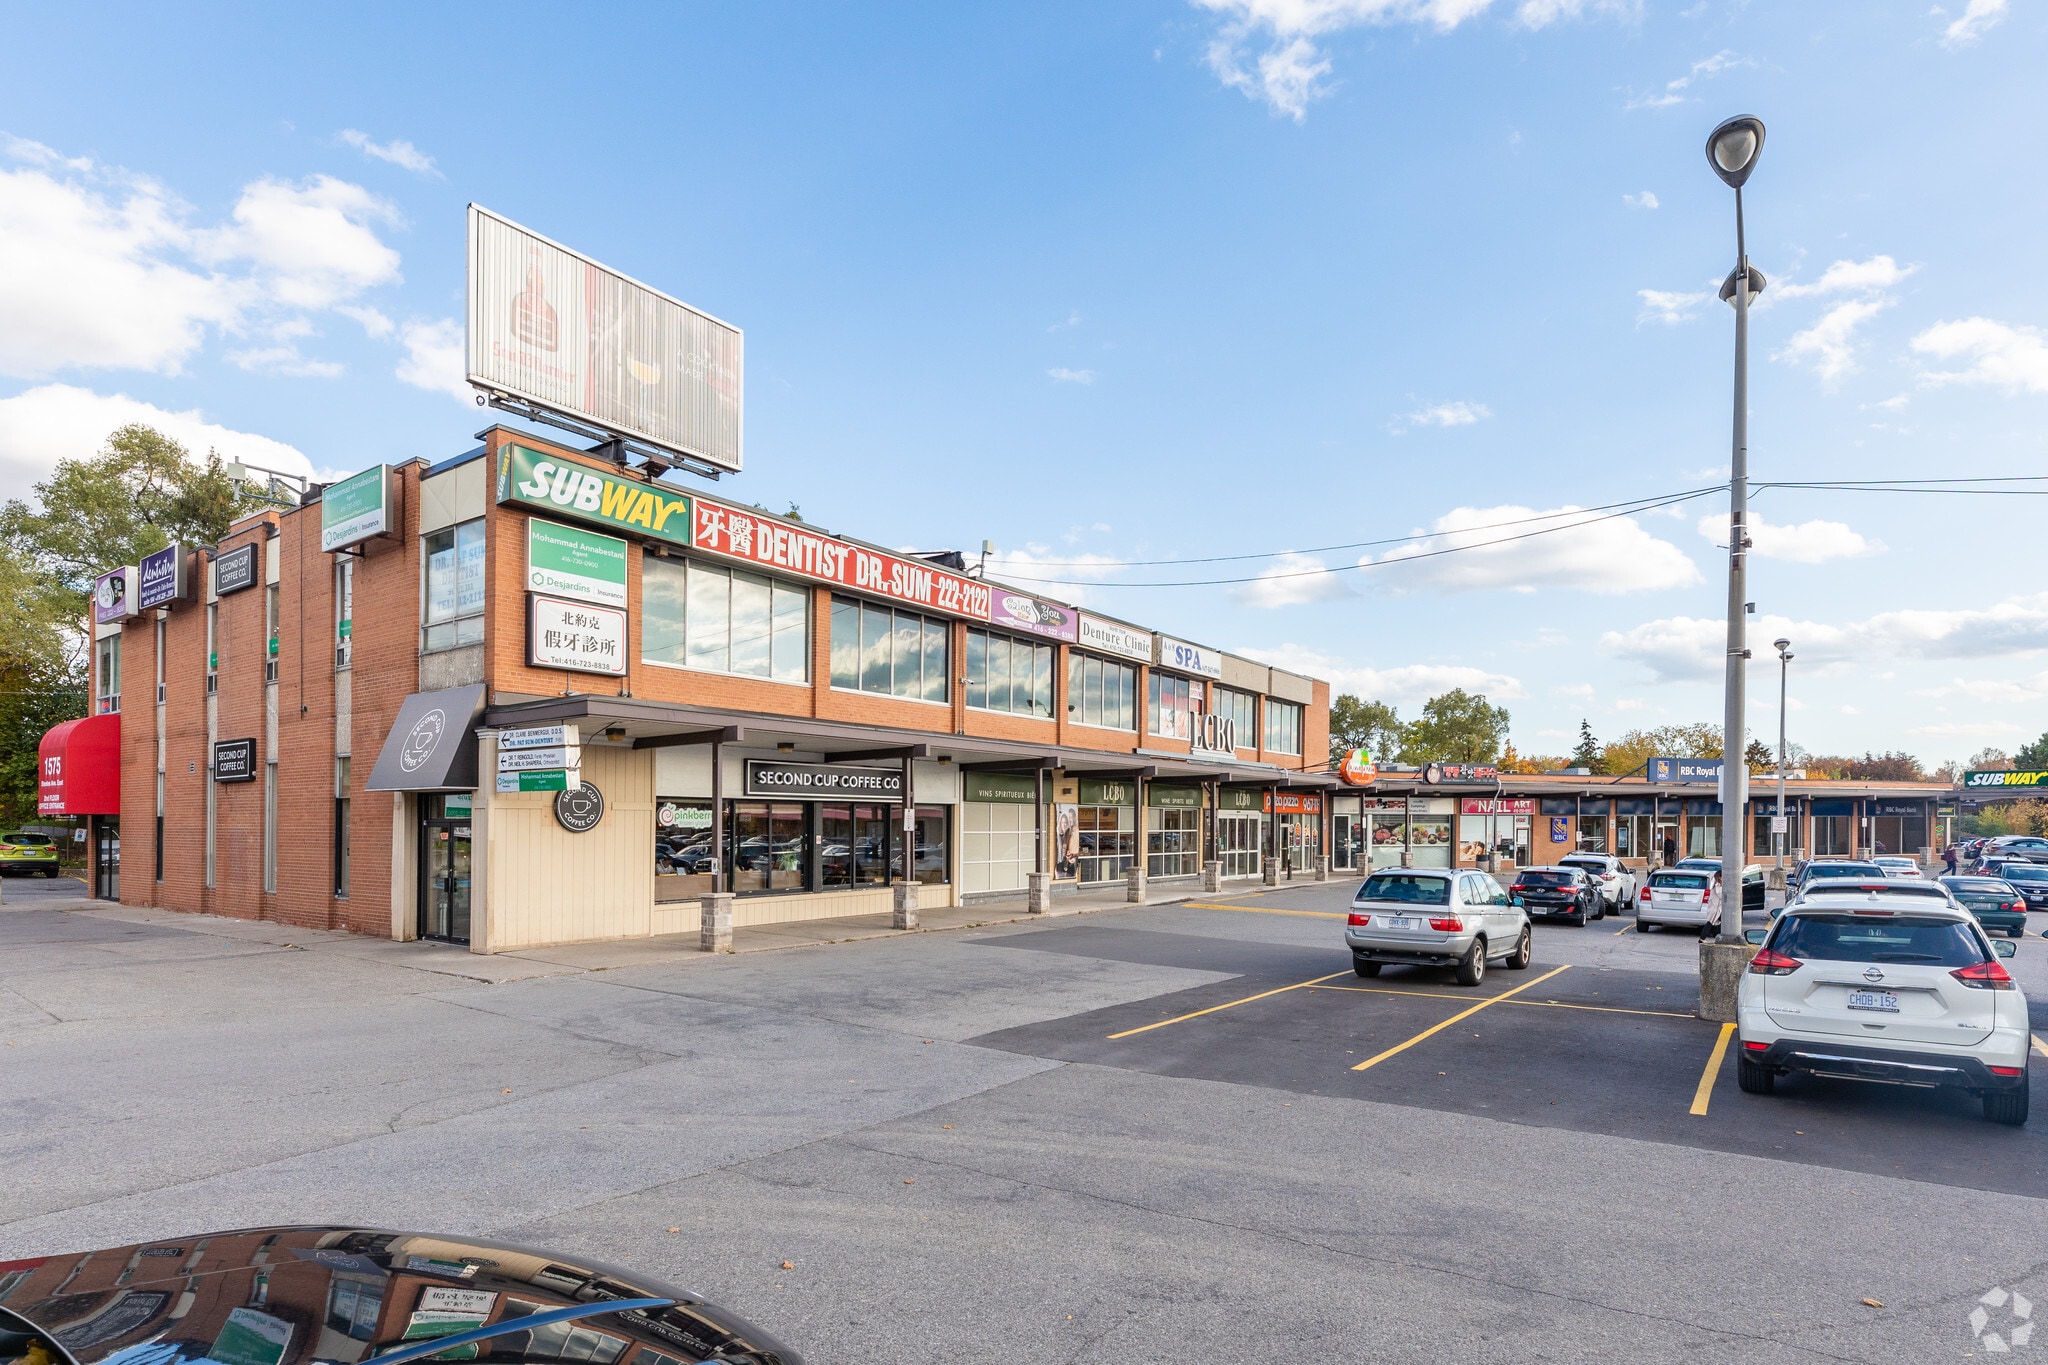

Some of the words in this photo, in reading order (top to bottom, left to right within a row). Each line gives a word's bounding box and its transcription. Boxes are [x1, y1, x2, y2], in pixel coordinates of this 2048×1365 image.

[498, 445, 510, 500] SUBWAY
[518, 462, 686, 531] SUBWAY
[333, 525, 359, 541] Desjardins
[697, 504, 755, 556] 牙醫
[532, 531, 579, 550] Mohammad
[580, 542, 625, 560] Annabestani
[571, 549, 589, 559] Agent
[143, 556, 175, 583] dentistry
[220, 559, 238, 574] SECOND
[238, 555, 249, 567] CUP
[561, 556, 600, 569] 416-730-0900
[757, 519, 850, 581] DENTIST
[938, 575, 989, 618] 222-2122
[221, 570, 238, 584] COFFEE
[442, 564, 480, 585] DETIST
[546, 575, 591, 594] Desjardins
[597, 588, 624, 600] Insurance
[1006, 597, 1032, 616] Salon
[1040, 604, 1061, 621] You
[561, 611, 601, 630] 北約克
[544, 629, 616, 657] 假牙診所
[1083, 621, 1121, 645] Denture
[1124, 634, 1150, 653] Clinic
[550, 656, 611, 671] Tel:416-723-8838
[1175, 645, 1202, 671] SPA
[1191, 711, 1237, 754] LCBO
[219, 750, 237, 761] SECOND
[236, 749, 247, 759] CUP
[44, 756, 61, 776] 1575
[220, 761, 237, 772] COFFEE
[1680, 766, 1695, 776] RBC
[1696, 766, 1715, 777] Royal
[759, 770, 812, 787] SECOND
[815, 773, 839, 788] CUP
[841, 775, 882, 789] COFFEE
[1967, 771, 2048, 787] SUBWAY
[563, 786, 586, 803] SECOD
[586, 789, 598, 803] CUP
[978, 789, 993, 798] VINS
[994, 790, 1025, 799] SPIRITUEUX
[1103, 784, 1125, 802] LCBO
[1235, 792, 1251, 807] LCBO
[1282, 796, 1299, 810] pizza
[1477, 800, 1511, 813] NAIL
[1513, 800, 1531, 808] ART
[1895, 806, 1906, 814] Royal
[564, 811, 586, 827] COFFEE
[674, 810, 712, 823] pinkberr
[1879, 995, 1898, 1008] 152
